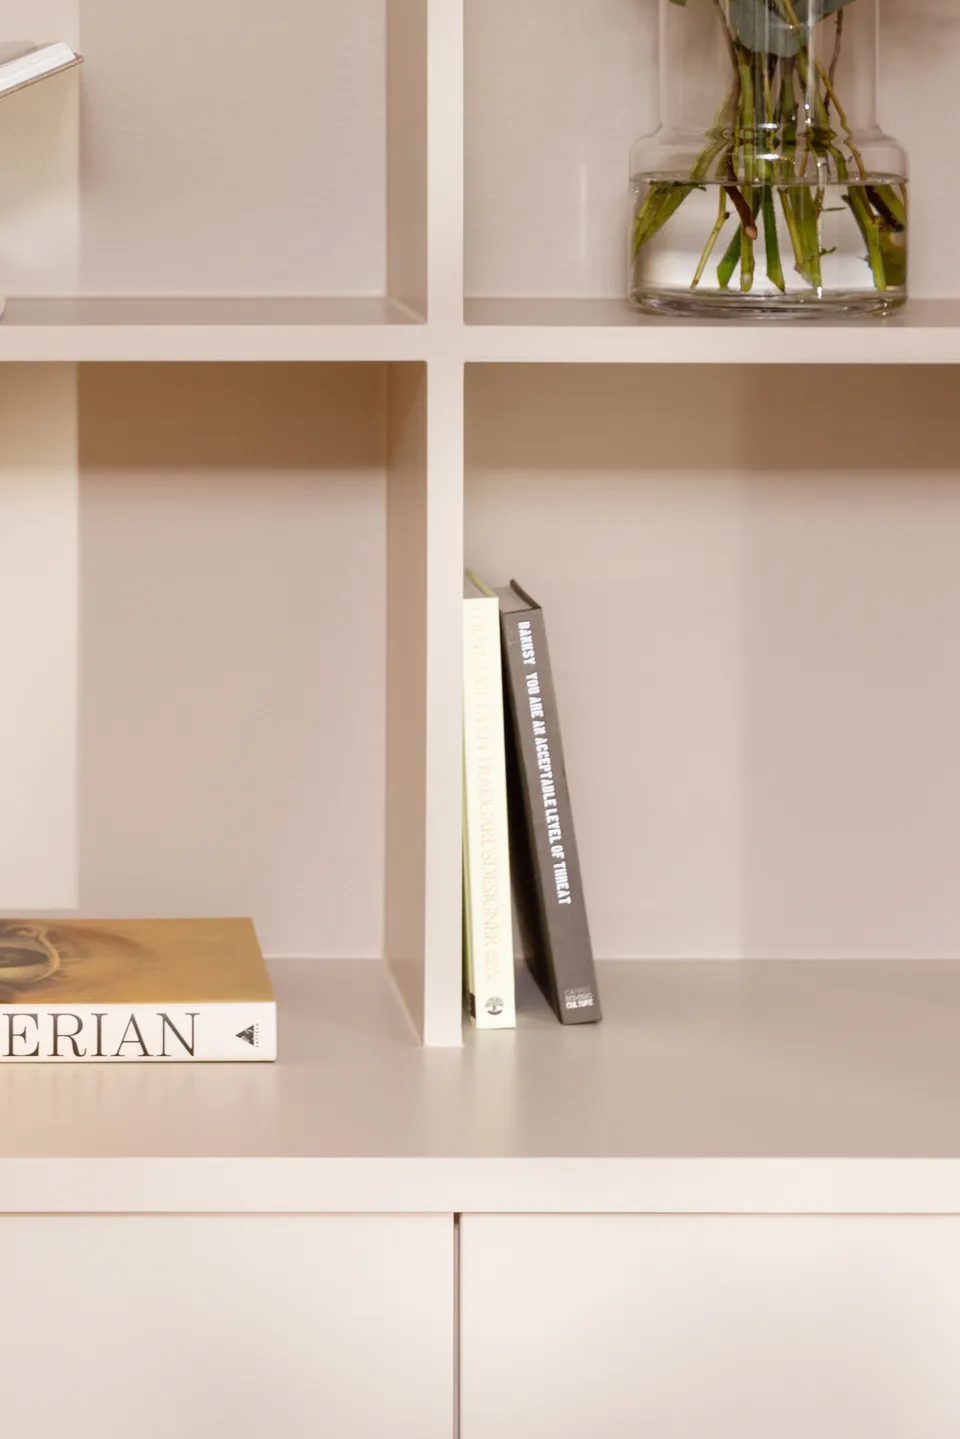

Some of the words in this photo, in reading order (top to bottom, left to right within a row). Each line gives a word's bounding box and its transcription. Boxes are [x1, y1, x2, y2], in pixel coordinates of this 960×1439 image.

[518, 621, 536, 665] BANKSY
[526, 672, 540, 694] YOU
[529, 696, 544, 718] ARE
[532, 720, 547, 735] AN
[535, 737, 557, 807] ACCEPTABLE
[545, 808, 562, 844] LEVEL
[551, 845, 565, 859] OF
[553, 861, 572, 904] THREAT
